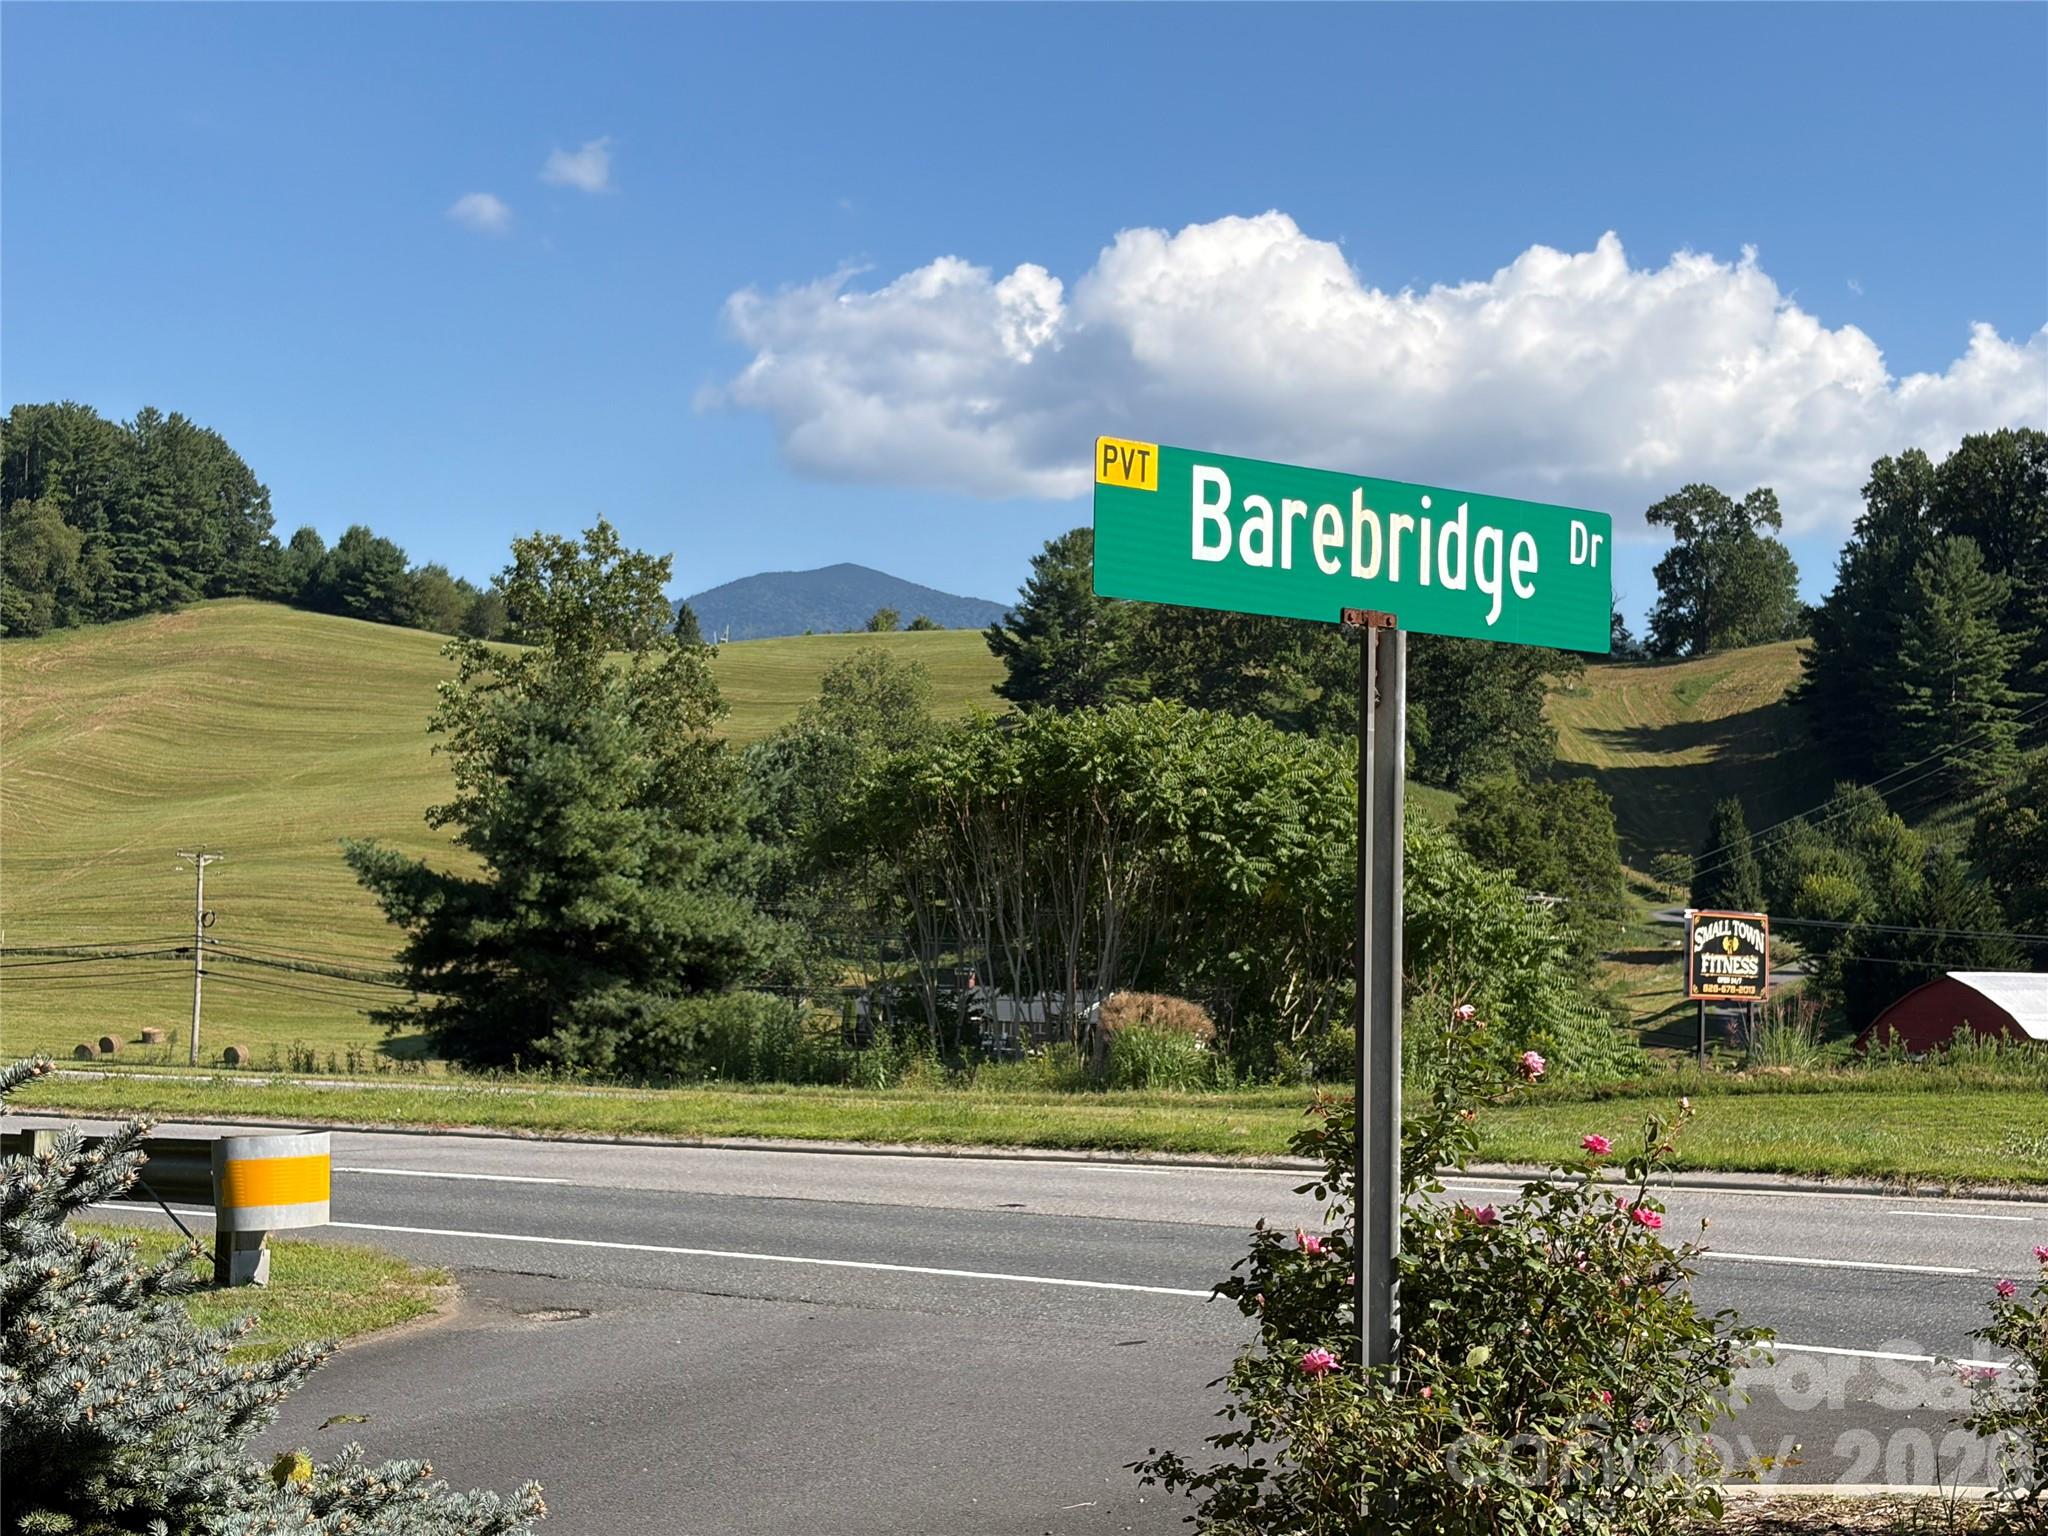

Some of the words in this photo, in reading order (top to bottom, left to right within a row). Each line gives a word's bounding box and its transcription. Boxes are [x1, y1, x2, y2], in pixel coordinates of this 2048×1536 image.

[1103, 444, 1150, 482] PVT
[1191, 464, 1539, 626] Barebridge
[1570, 520, 1603, 567] Dr
[1694, 920, 1732, 953] SMALL
[1732, 920, 1765, 954] TOWN
[1701, 953, 1759, 975] FITNESS
